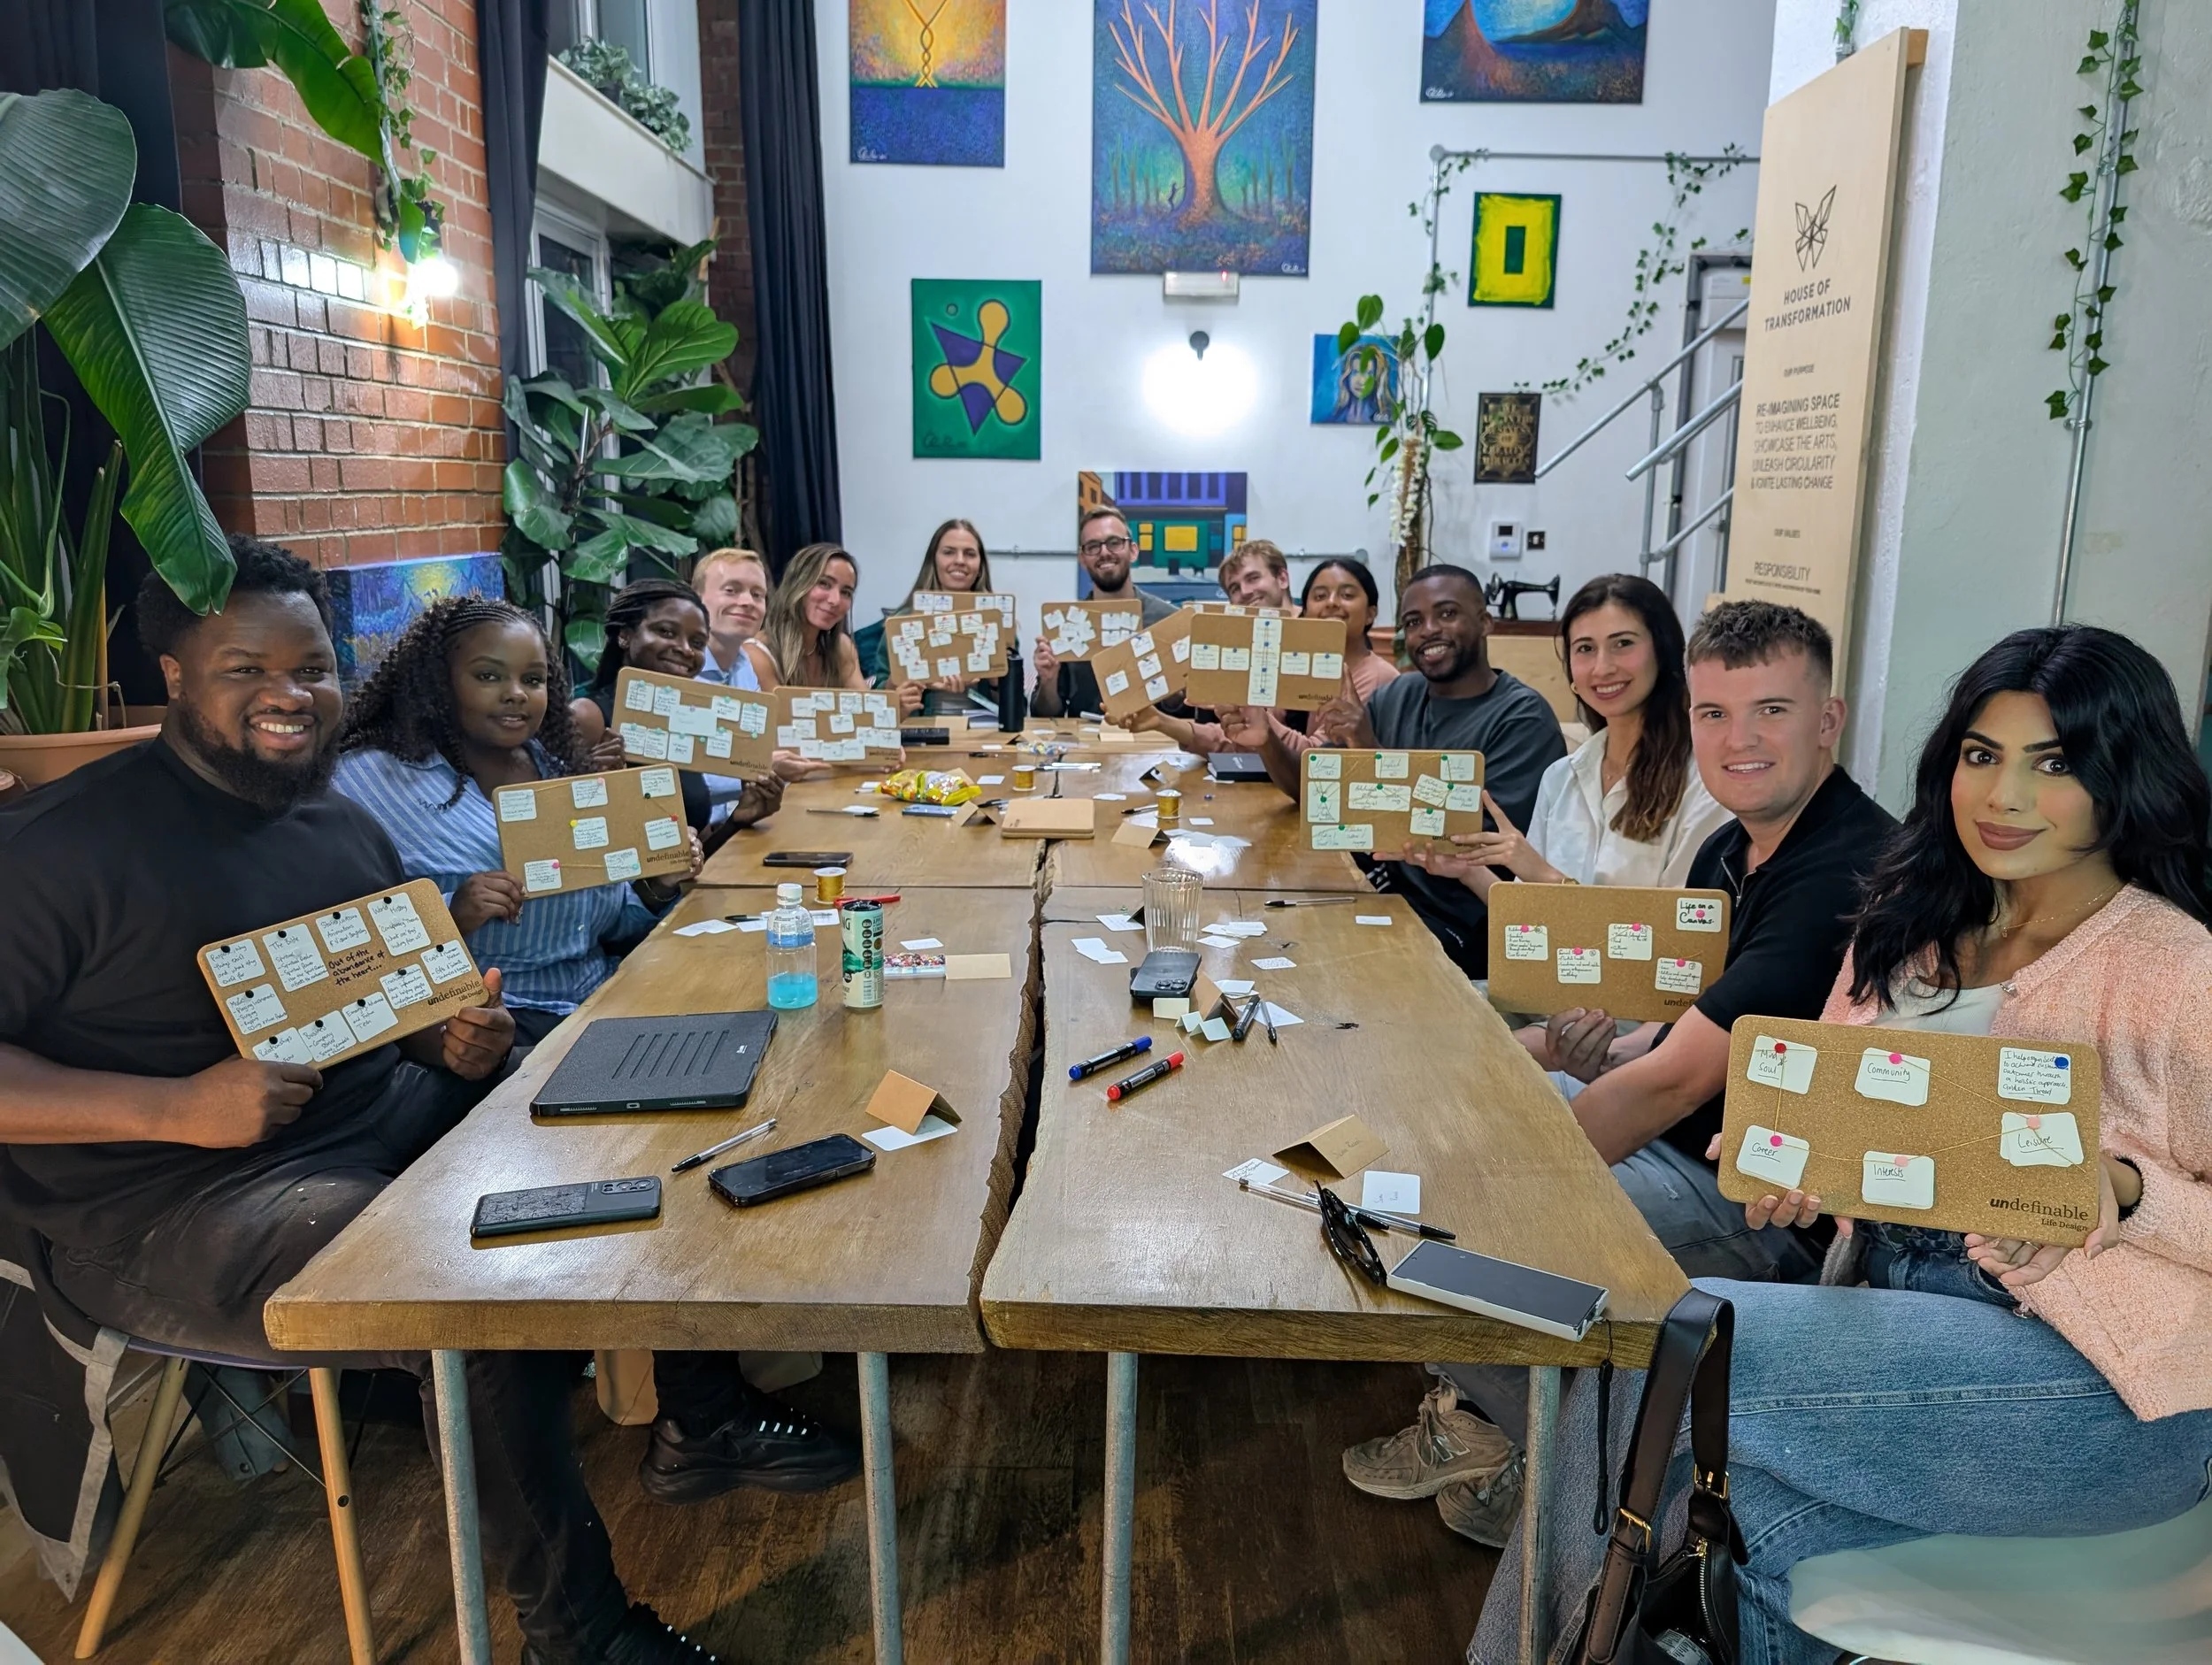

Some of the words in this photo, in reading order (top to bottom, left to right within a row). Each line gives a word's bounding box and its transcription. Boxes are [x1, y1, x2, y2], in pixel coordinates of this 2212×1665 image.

[1783, 283, 1814, 305] HOUSE
[1816, 279, 1831, 295] OF
[1764, 295, 1851, 333] TRANSFORMATION
[1756, 396, 1809, 418] RE-IMAGINING
[1810, 393, 1840, 410] SPACE
[1755, 422, 1763, 434] TO
[1764, 418, 1795, 434] ENHANCE
[1754, 437, 1794, 453] SHOWCASE
[1796, 435, 1812, 451] THE
[1752, 456, 1783, 472] UNLEASH
[1785, 455, 1836, 472] CIRCULARITY
[1755, 477, 1776, 489] IGNITE
[1776, 476, 1802, 489] LASTING
[1803, 475, 1833, 489] CHANGE
[1754, 561, 1811, 581] RESPONSIBILITY
[647, 849, 689, 863] undefinable
[372, 904, 388, 915] World
[390, 904, 408, 914] History
[1680, 901, 1696, 914] Life
[269, 940, 283, 951] The
[285, 936, 300, 945] Bible
[328, 958, 343, 970] Out
[346, 951, 356, 962] of
[355, 949, 369, 958] the
[333, 955, 374, 977] abundance
[377, 949, 386, 960] of
[335, 976, 351, 986] the
[351, 963, 382, 978] heart...
[427, 980, 480, 1006] undefinable
[257, 1036, 293, 1057] Relationships
[1760, 1049, 1778, 1061] Mind
[2004, 1050, 2012, 1059] I
[2013, 1052, 2026, 1062] help
[1758, 1063, 1777, 1075] Soul
[1867, 1062, 1910, 1081] Community
[2015, 1076, 2036, 1086] holistic
[2030, 1086, 2053, 1096] Thread
[2017, 1133, 2053, 1148] Leisure
[1751, 1141, 1778, 1157] Career
[1873, 1164, 1904, 1178] Interests
[1990, 1198, 2088, 1221] undefinable
[2040, 1218, 2057, 1227] Life
[2059, 1222, 2088, 1232] Design
